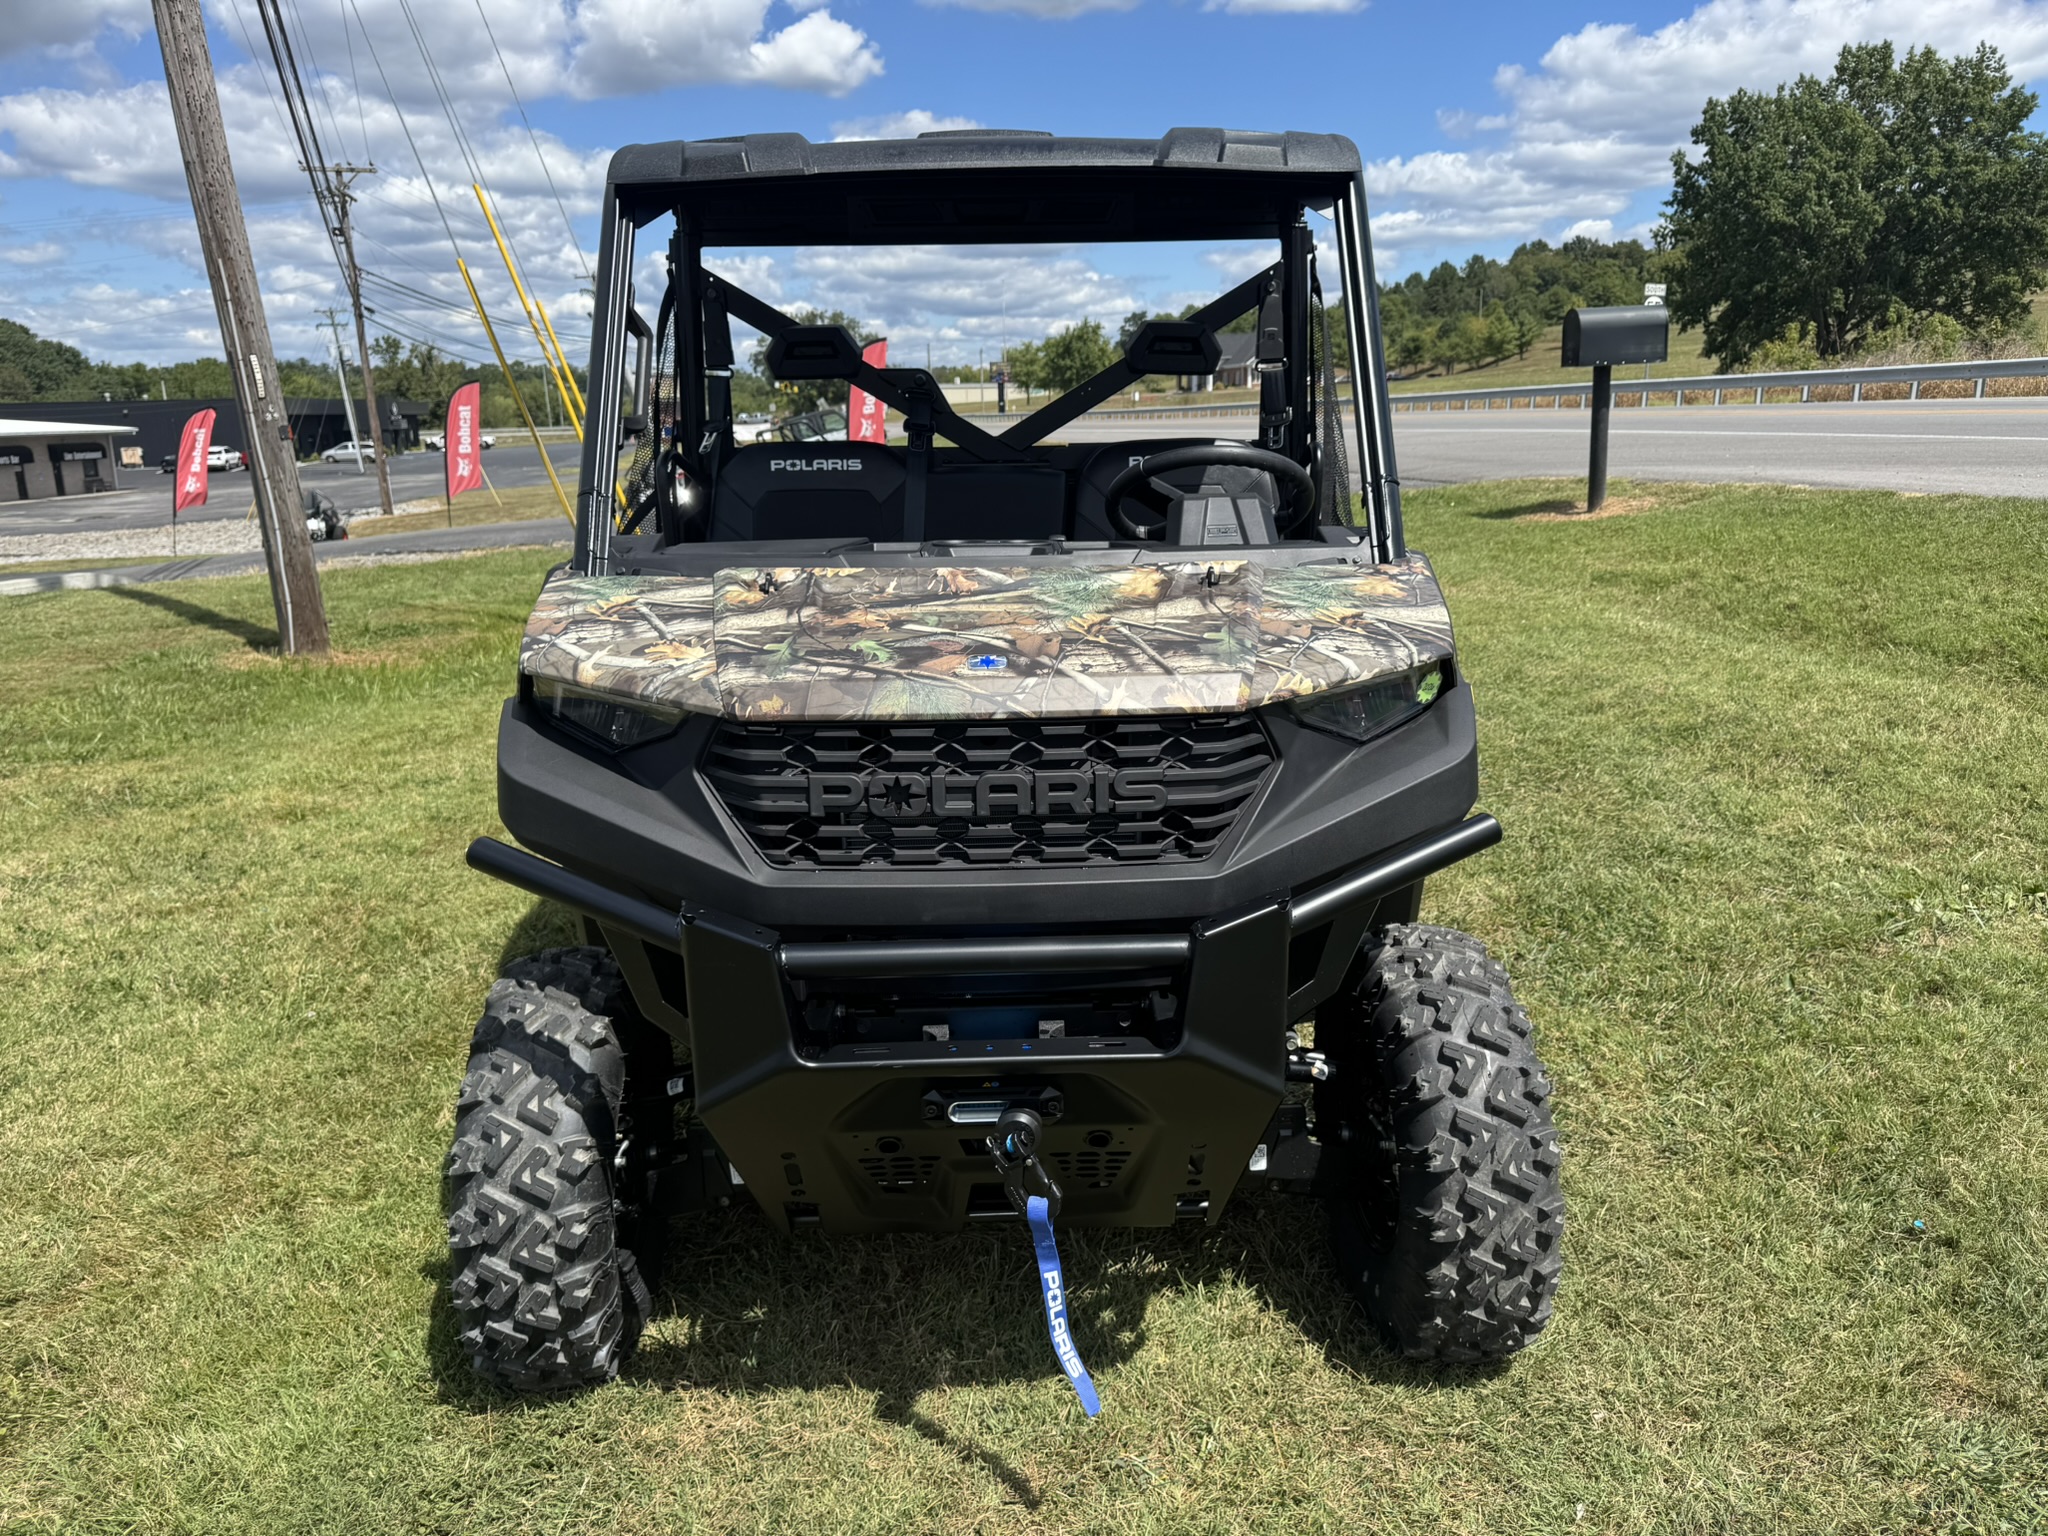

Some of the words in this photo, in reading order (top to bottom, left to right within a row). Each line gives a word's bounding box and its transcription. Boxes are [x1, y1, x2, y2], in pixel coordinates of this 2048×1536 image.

[190, 428, 207, 473] Bobcat
[457, 405, 473, 454] Bobcat
[770, 459, 863, 472] POLARIS
[807, 766, 1169, 818] POLARIS
[1043, 1270, 1084, 1379] POLARIS
